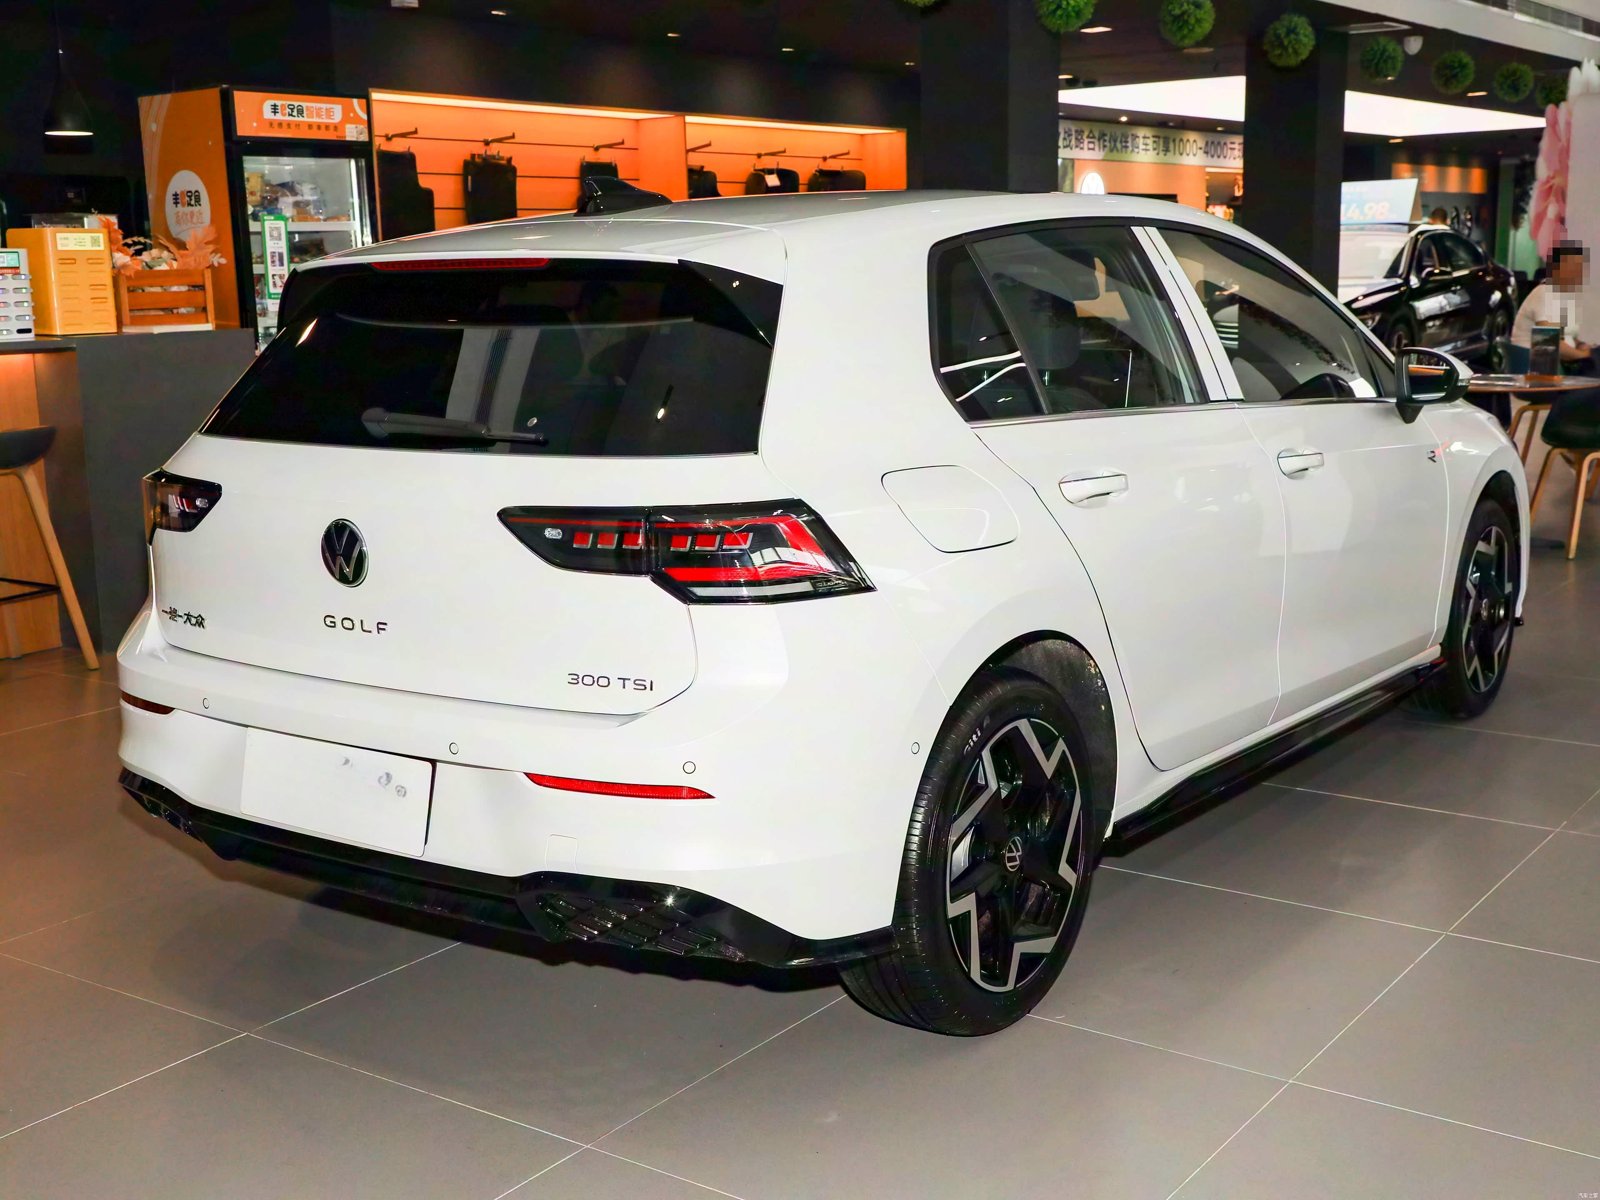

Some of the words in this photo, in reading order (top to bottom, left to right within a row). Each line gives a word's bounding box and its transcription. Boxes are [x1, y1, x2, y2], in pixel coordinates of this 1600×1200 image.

[323, 614, 388, 634] GOLF
[567, 672, 611, 688] 300
[617, 677, 654, 691] TSI
